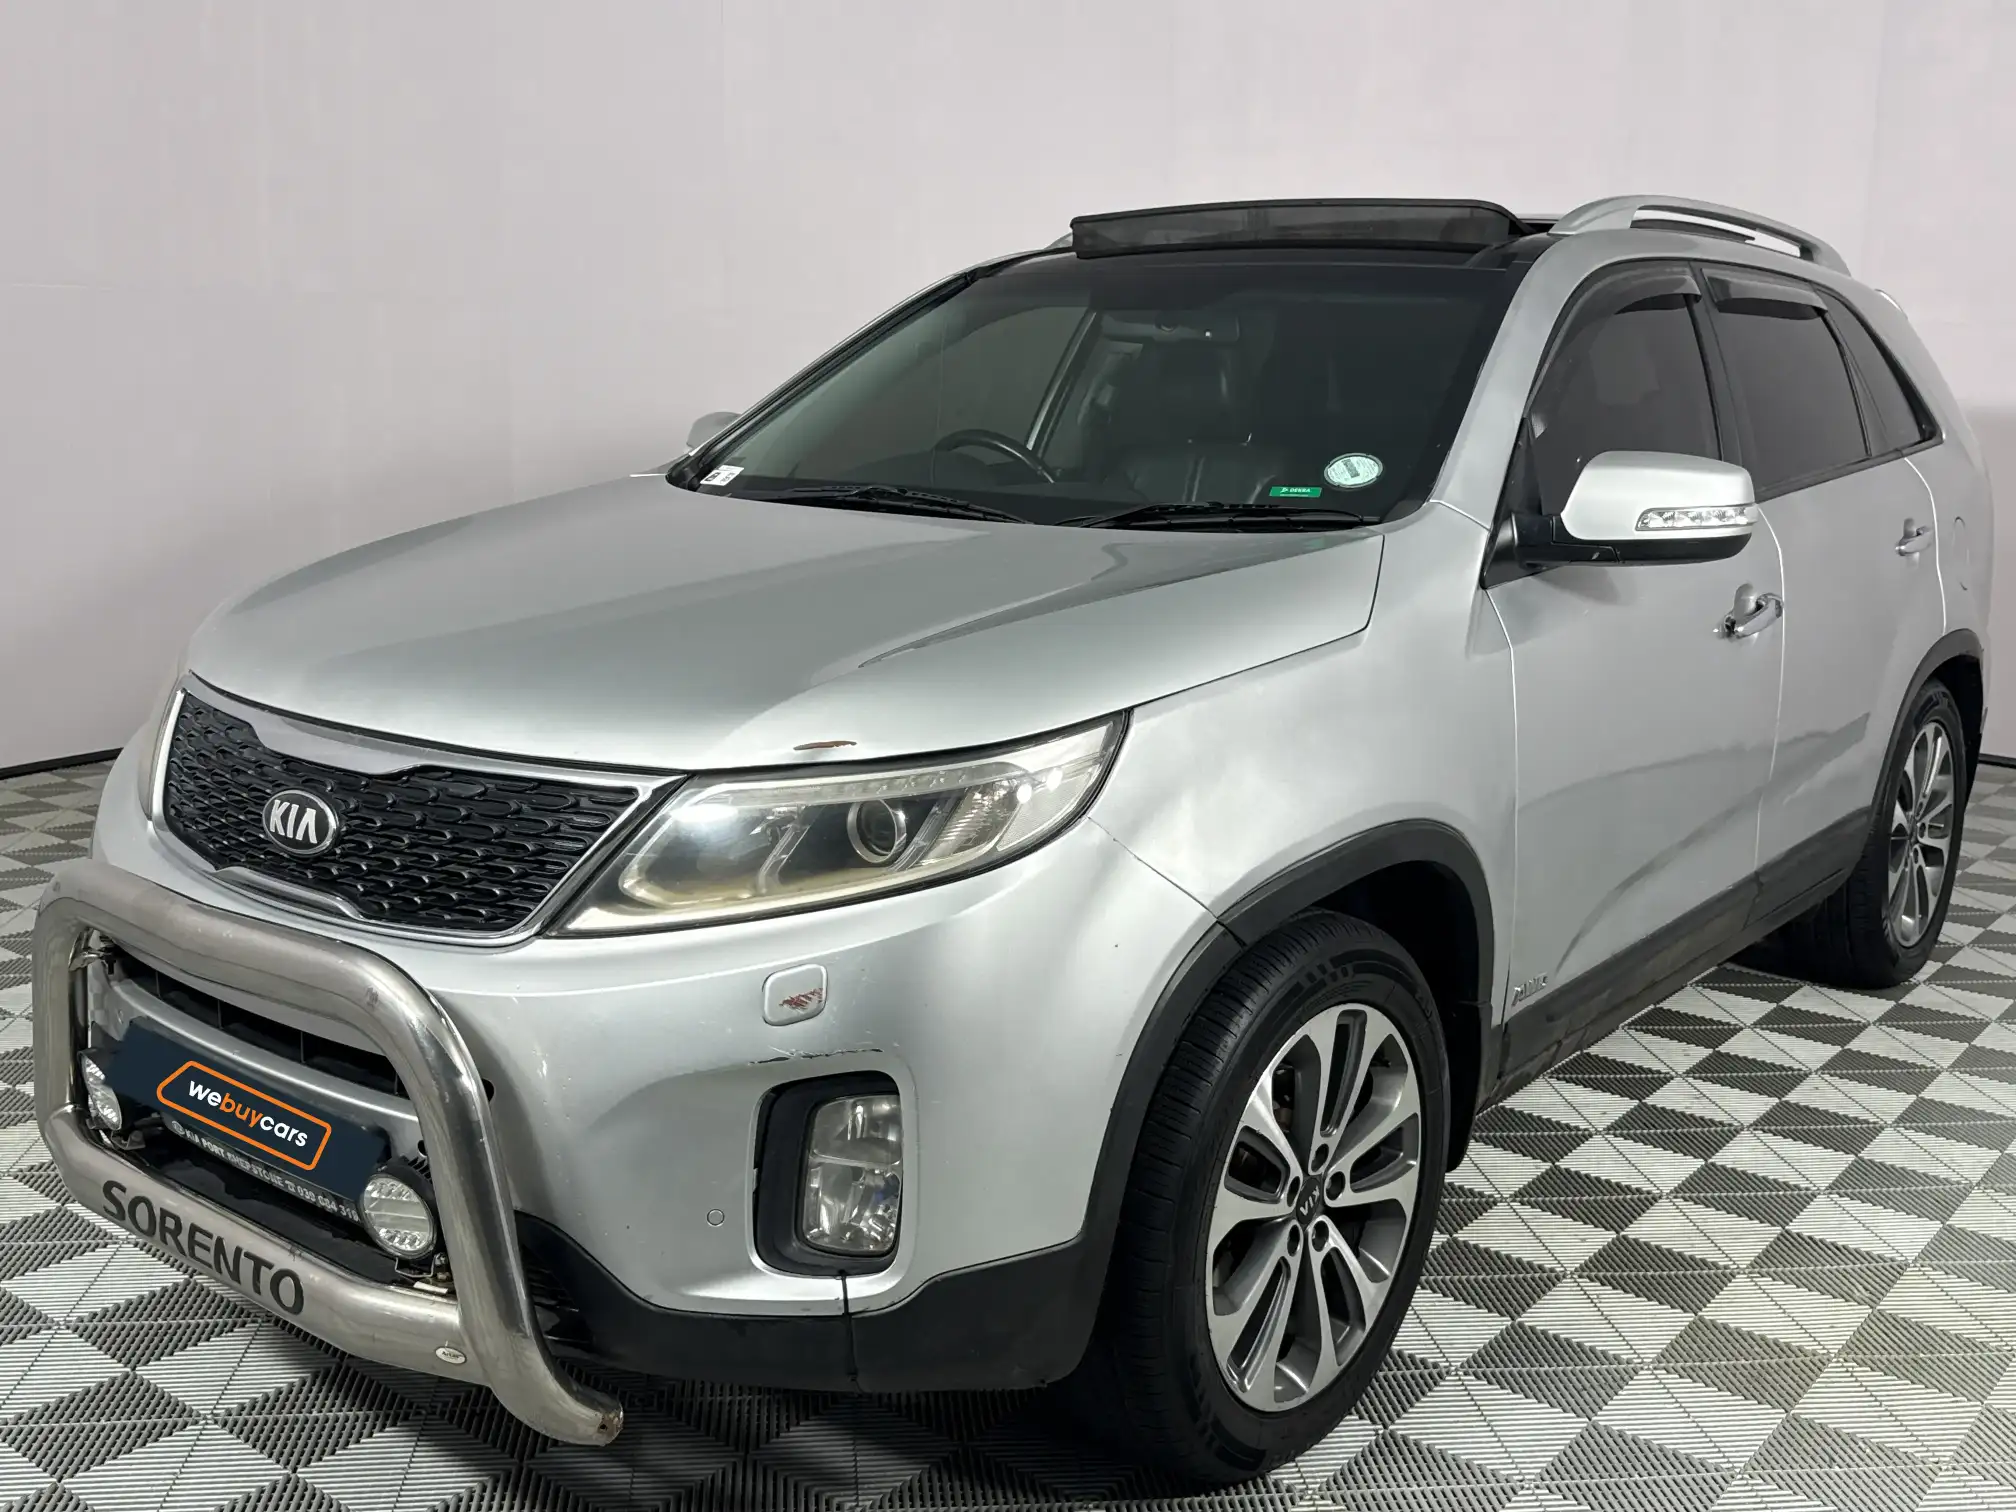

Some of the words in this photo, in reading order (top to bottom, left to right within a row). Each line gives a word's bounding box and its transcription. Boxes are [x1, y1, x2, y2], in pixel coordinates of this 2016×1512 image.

[269, 799, 318, 844] KIA
[200, 1137, 225, 1158] PORT
[296, 1185, 316, 1202] 039
[1299, 1185, 1320, 1216] KIA
[102, 1180, 305, 1315] SORENTO
